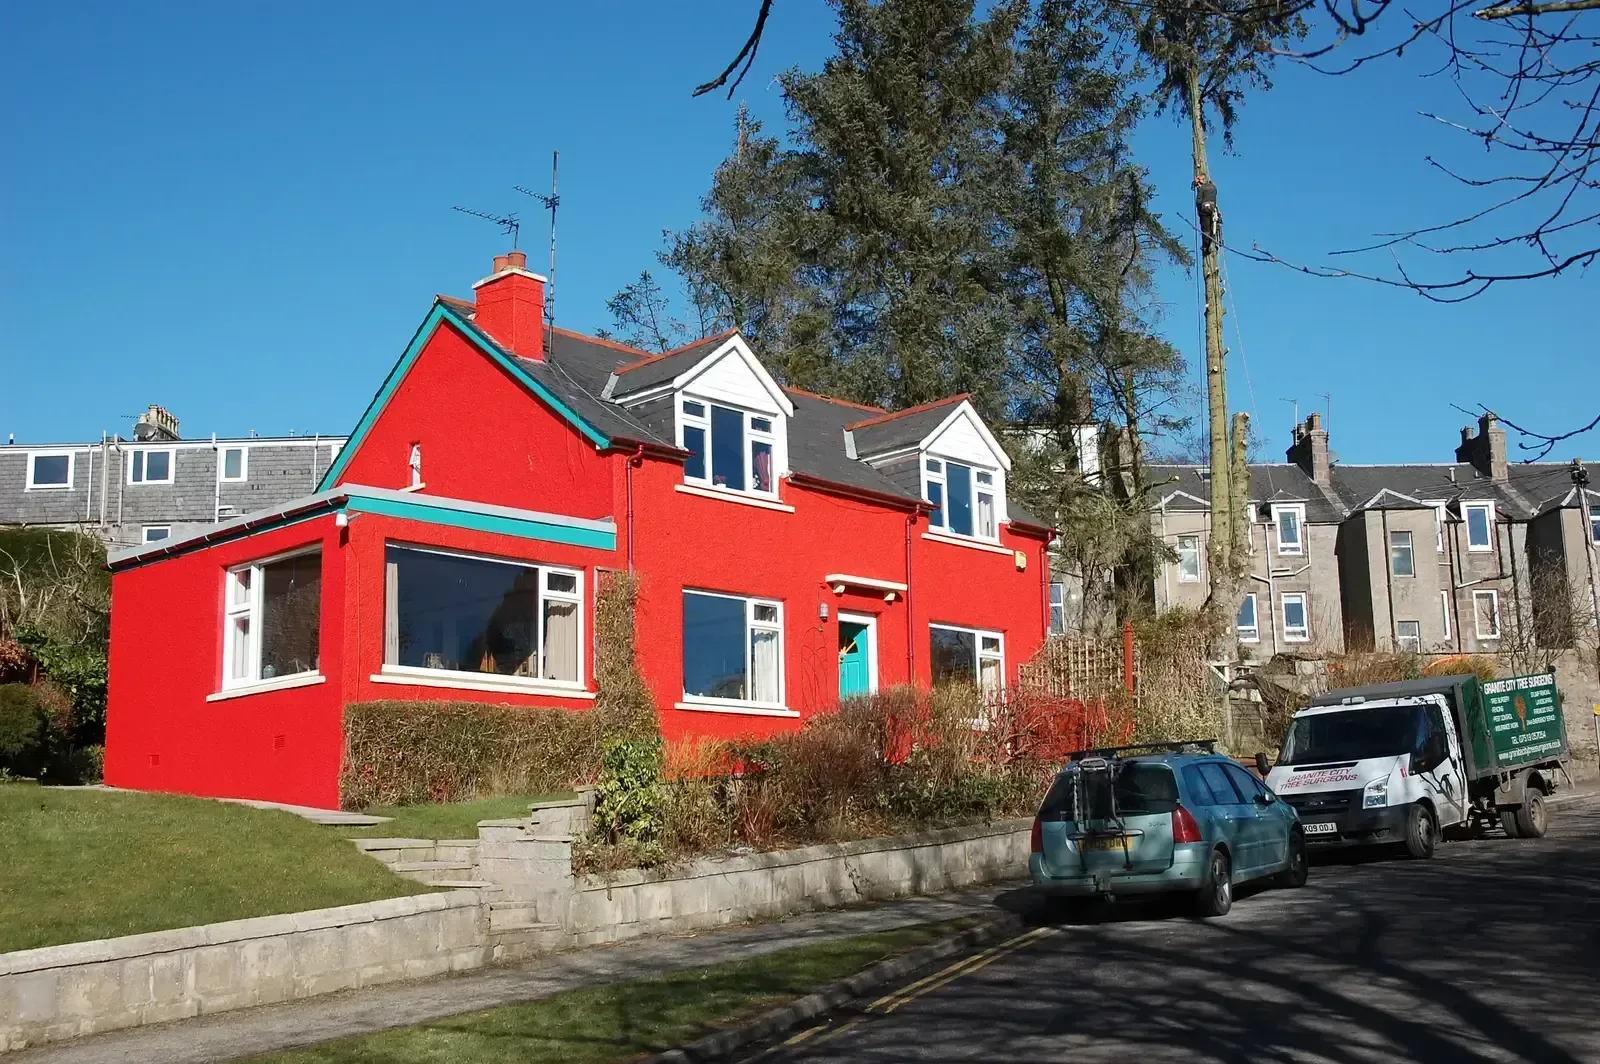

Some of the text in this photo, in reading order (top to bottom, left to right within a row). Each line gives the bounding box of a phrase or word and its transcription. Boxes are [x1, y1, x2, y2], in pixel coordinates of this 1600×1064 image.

[1484, 674, 1553, 695] GRANITE CITY TREE SURGEONS
[1280, 774, 1358, 791] TREE SURGEONS
[1287, 768, 1352, 783] GRANITE CITY
